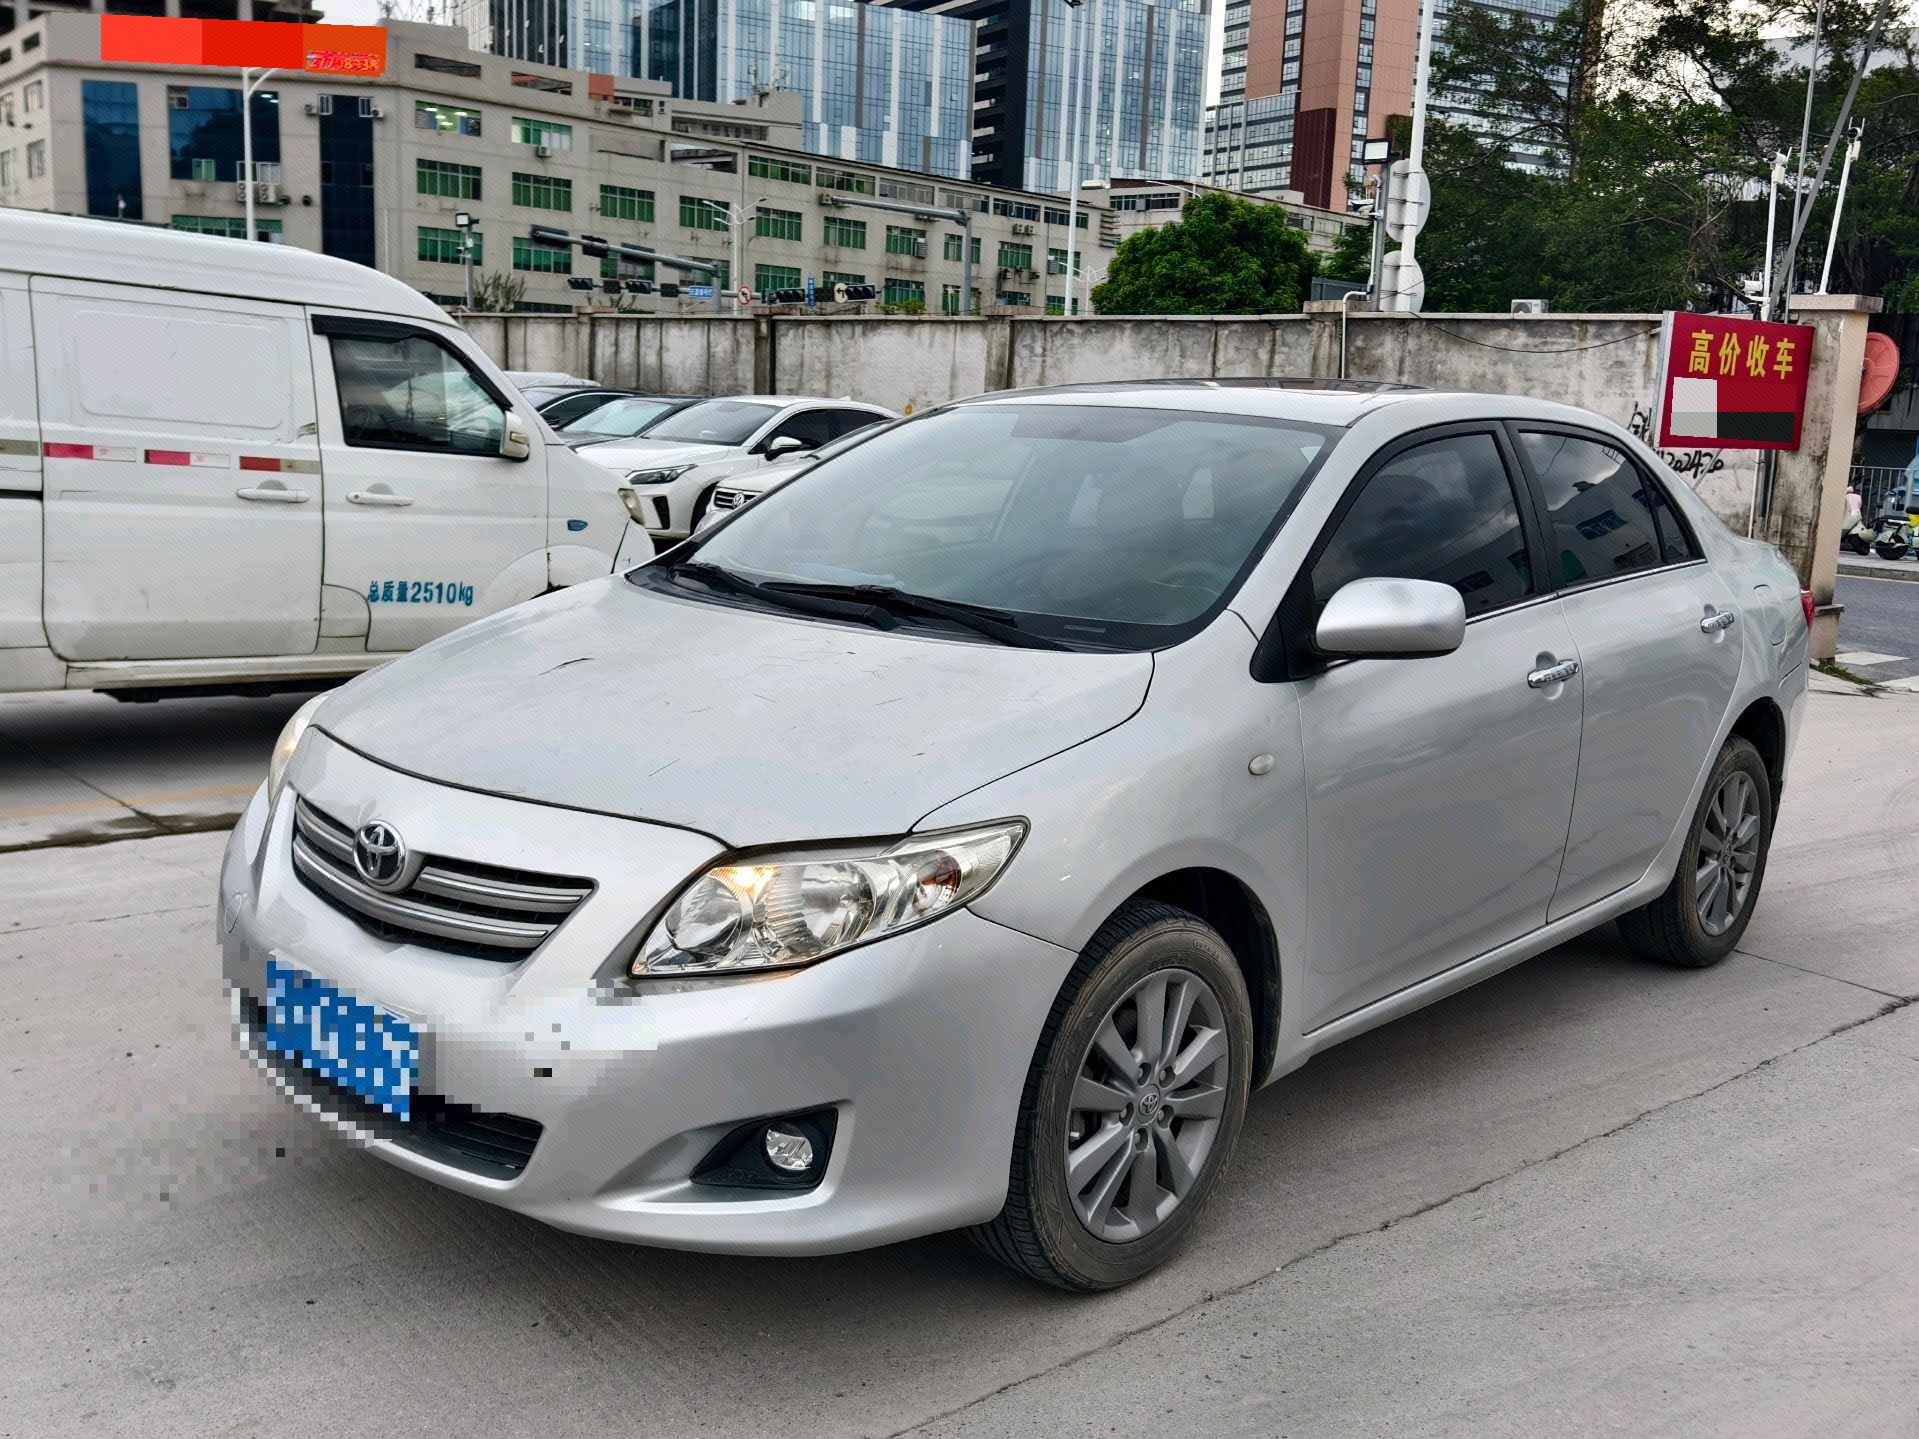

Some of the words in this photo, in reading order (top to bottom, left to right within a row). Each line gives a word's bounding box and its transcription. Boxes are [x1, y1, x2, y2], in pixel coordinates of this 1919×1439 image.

[1688, 329, 1795, 380] 高价收车
[368, 580, 473, 606] 总质量2510kg
